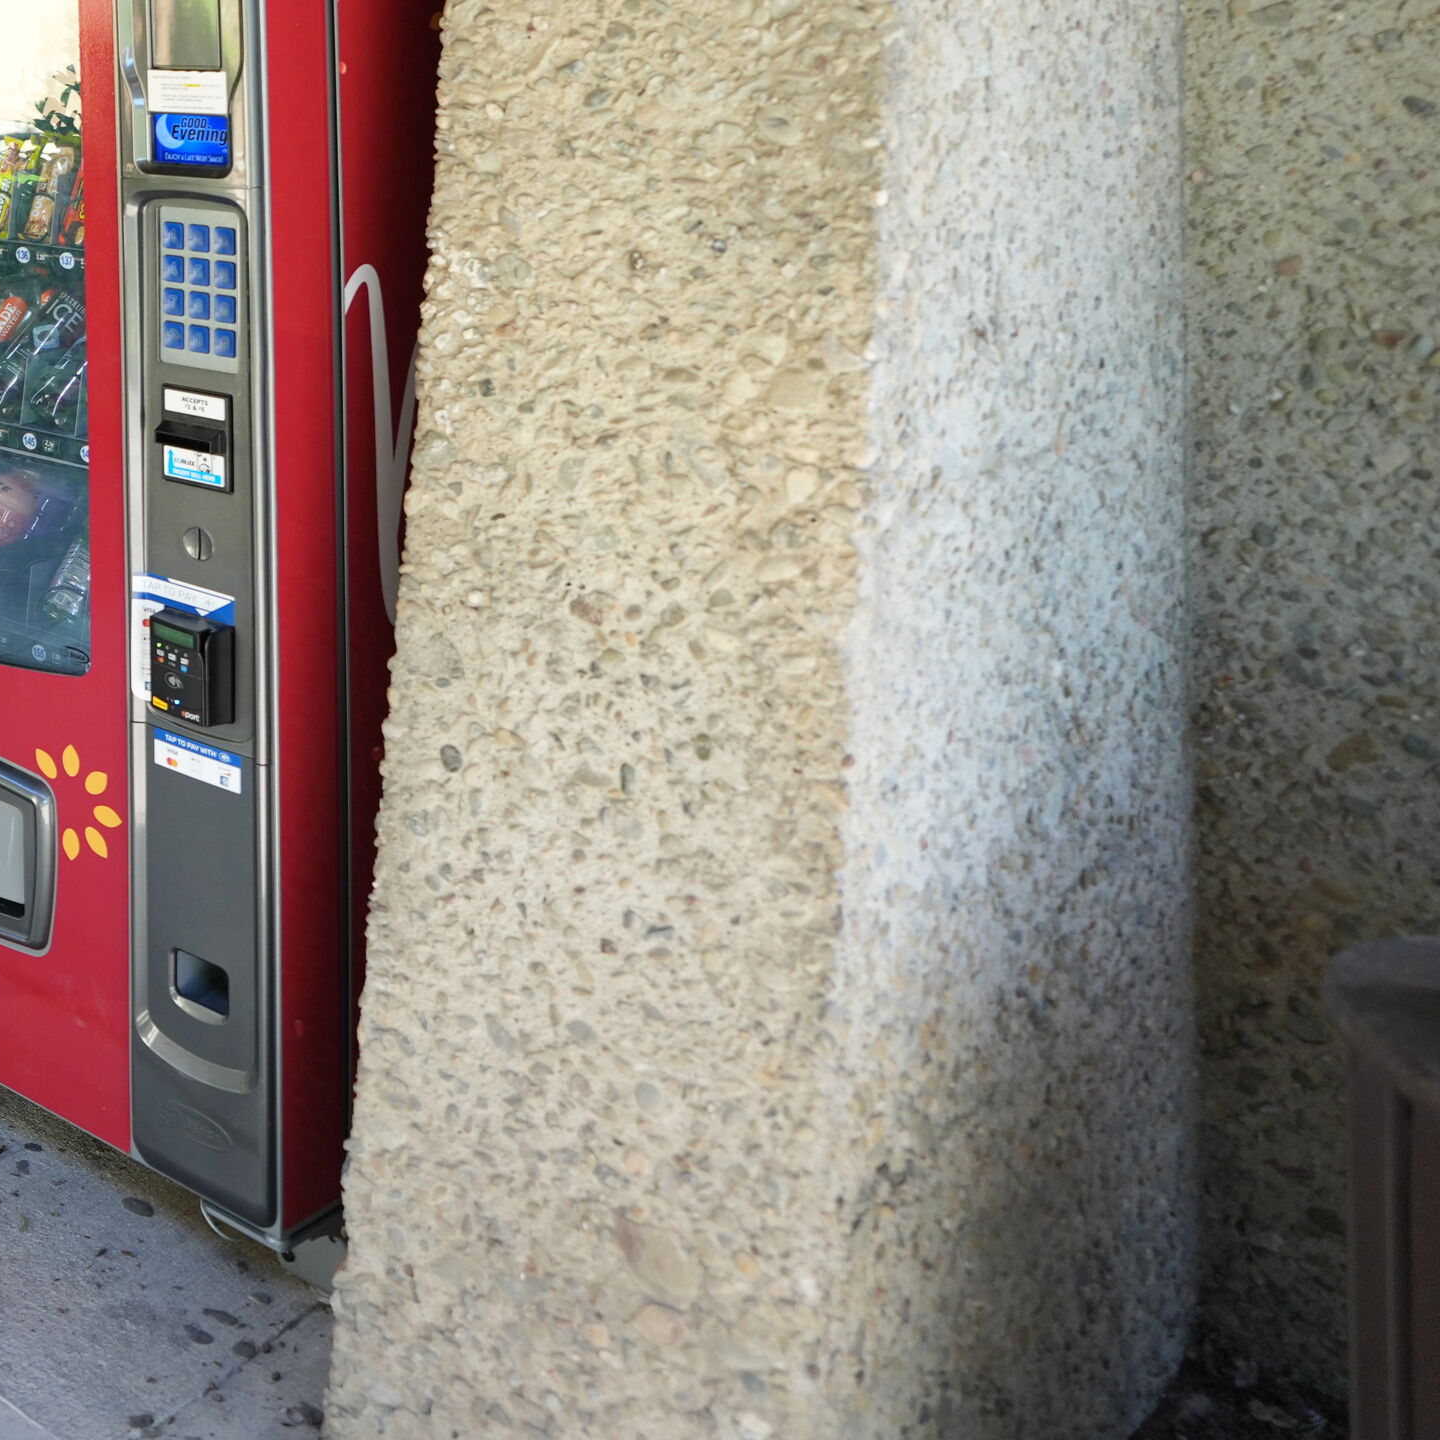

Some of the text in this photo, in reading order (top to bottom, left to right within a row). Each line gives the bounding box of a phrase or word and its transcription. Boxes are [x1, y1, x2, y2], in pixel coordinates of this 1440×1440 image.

[181, 117, 207, 129] GOOD
[172, 124, 228, 146] Evening
[16, 249, 29, 260] 136
[60, 254, 73, 266] 137
[59, 291, 86, 318] SPARKLIN
[0, 309, 22, 337] WATER
[46, 299, 83, 333] ICE
[181, 396, 208, 406] ACCEPTS
[23, 436, 35, 447] 145
[143, 579, 197, 603] TAP TO PAY
[165, 733, 218, 758] TAP TO PAY WITH
